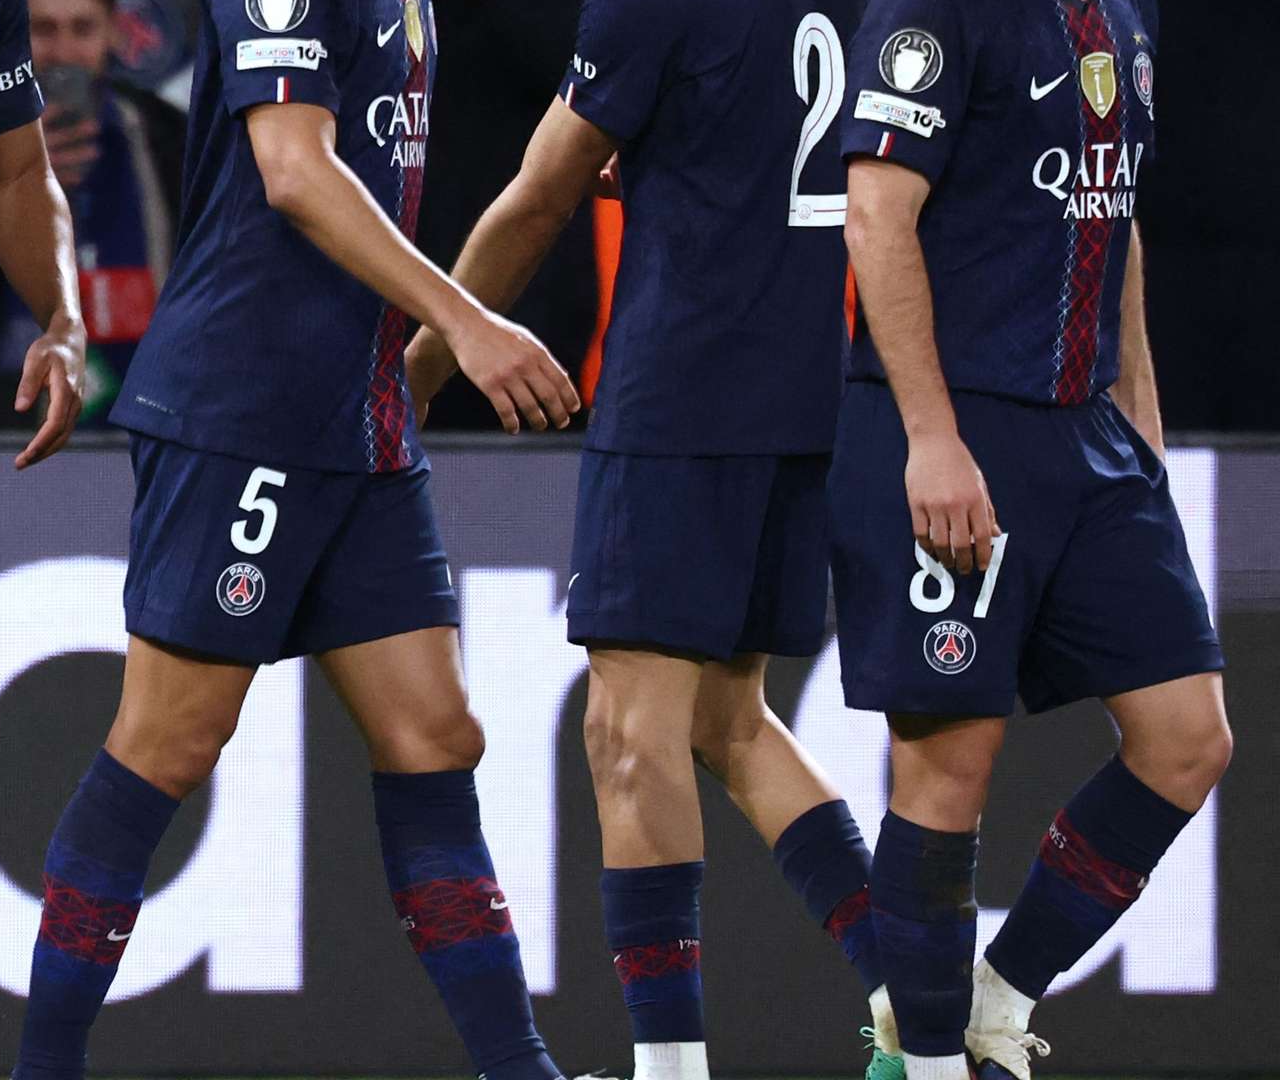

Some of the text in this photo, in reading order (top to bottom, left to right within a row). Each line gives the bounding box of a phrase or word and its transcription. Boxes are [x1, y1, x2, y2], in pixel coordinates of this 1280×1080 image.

[788, 12, 848, 226] 2
[230, 466, 288, 554] 5
[229, 566, 260, 582] PARIS
[909, 525, 1009, 618] 87
[933, 623, 968, 638] PARIS
